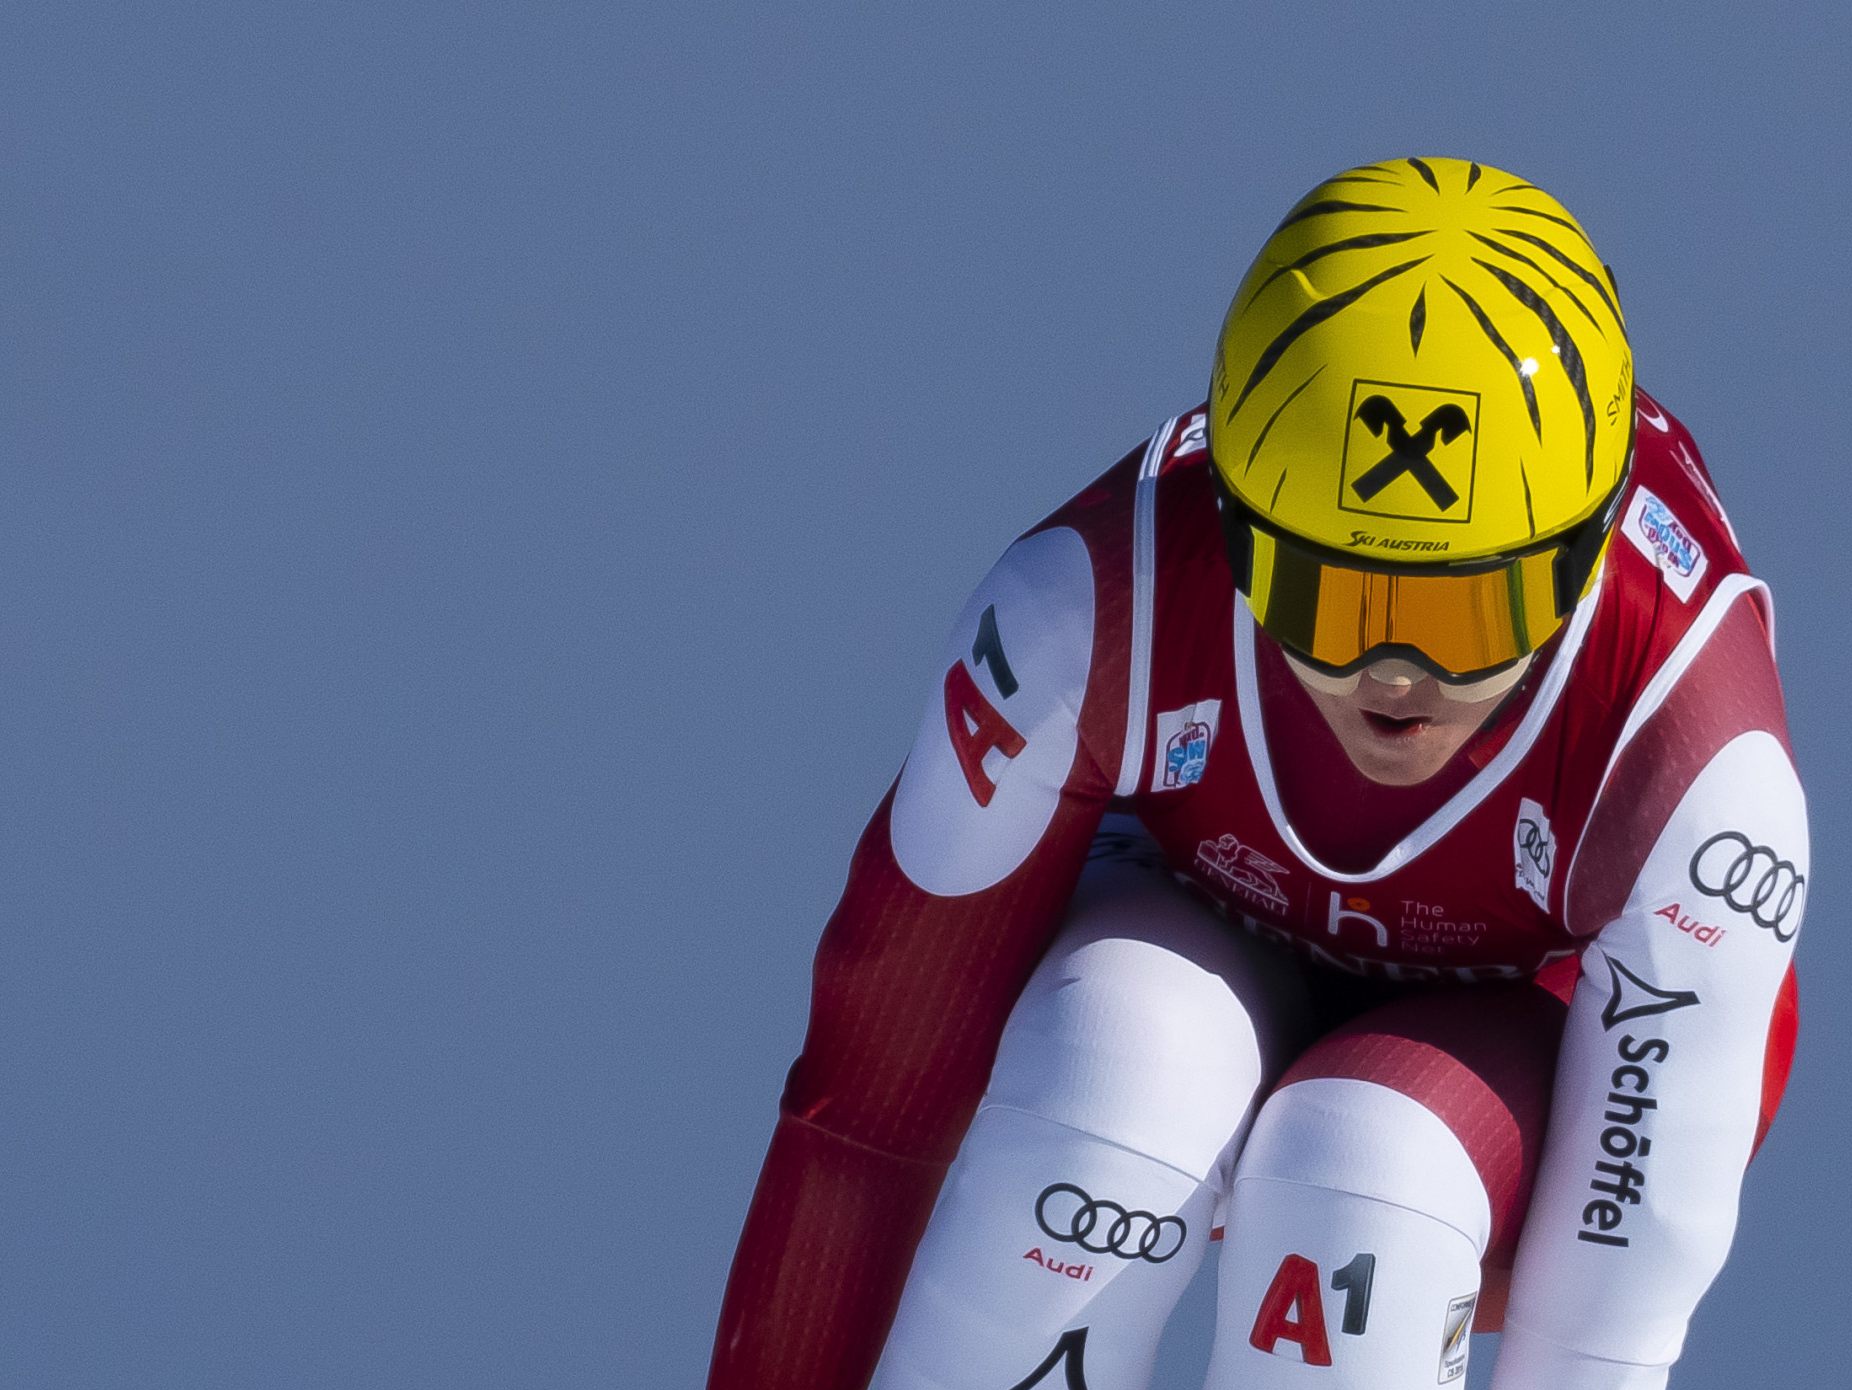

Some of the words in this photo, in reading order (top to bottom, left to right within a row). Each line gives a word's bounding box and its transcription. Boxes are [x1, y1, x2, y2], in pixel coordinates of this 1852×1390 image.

[1376, 538, 1450, 552] AUSTRIA
[944, 603, 1028, 808] A1
[1401, 900, 1445, 917] The
[1401, 916, 1488, 933] Human
[1401, 929, 1480, 946] Safety
[1653, 902, 1729, 949] Audi
[1022, 1246, 1095, 1283] Audi
[1249, 1252, 1377, 1367] A1
